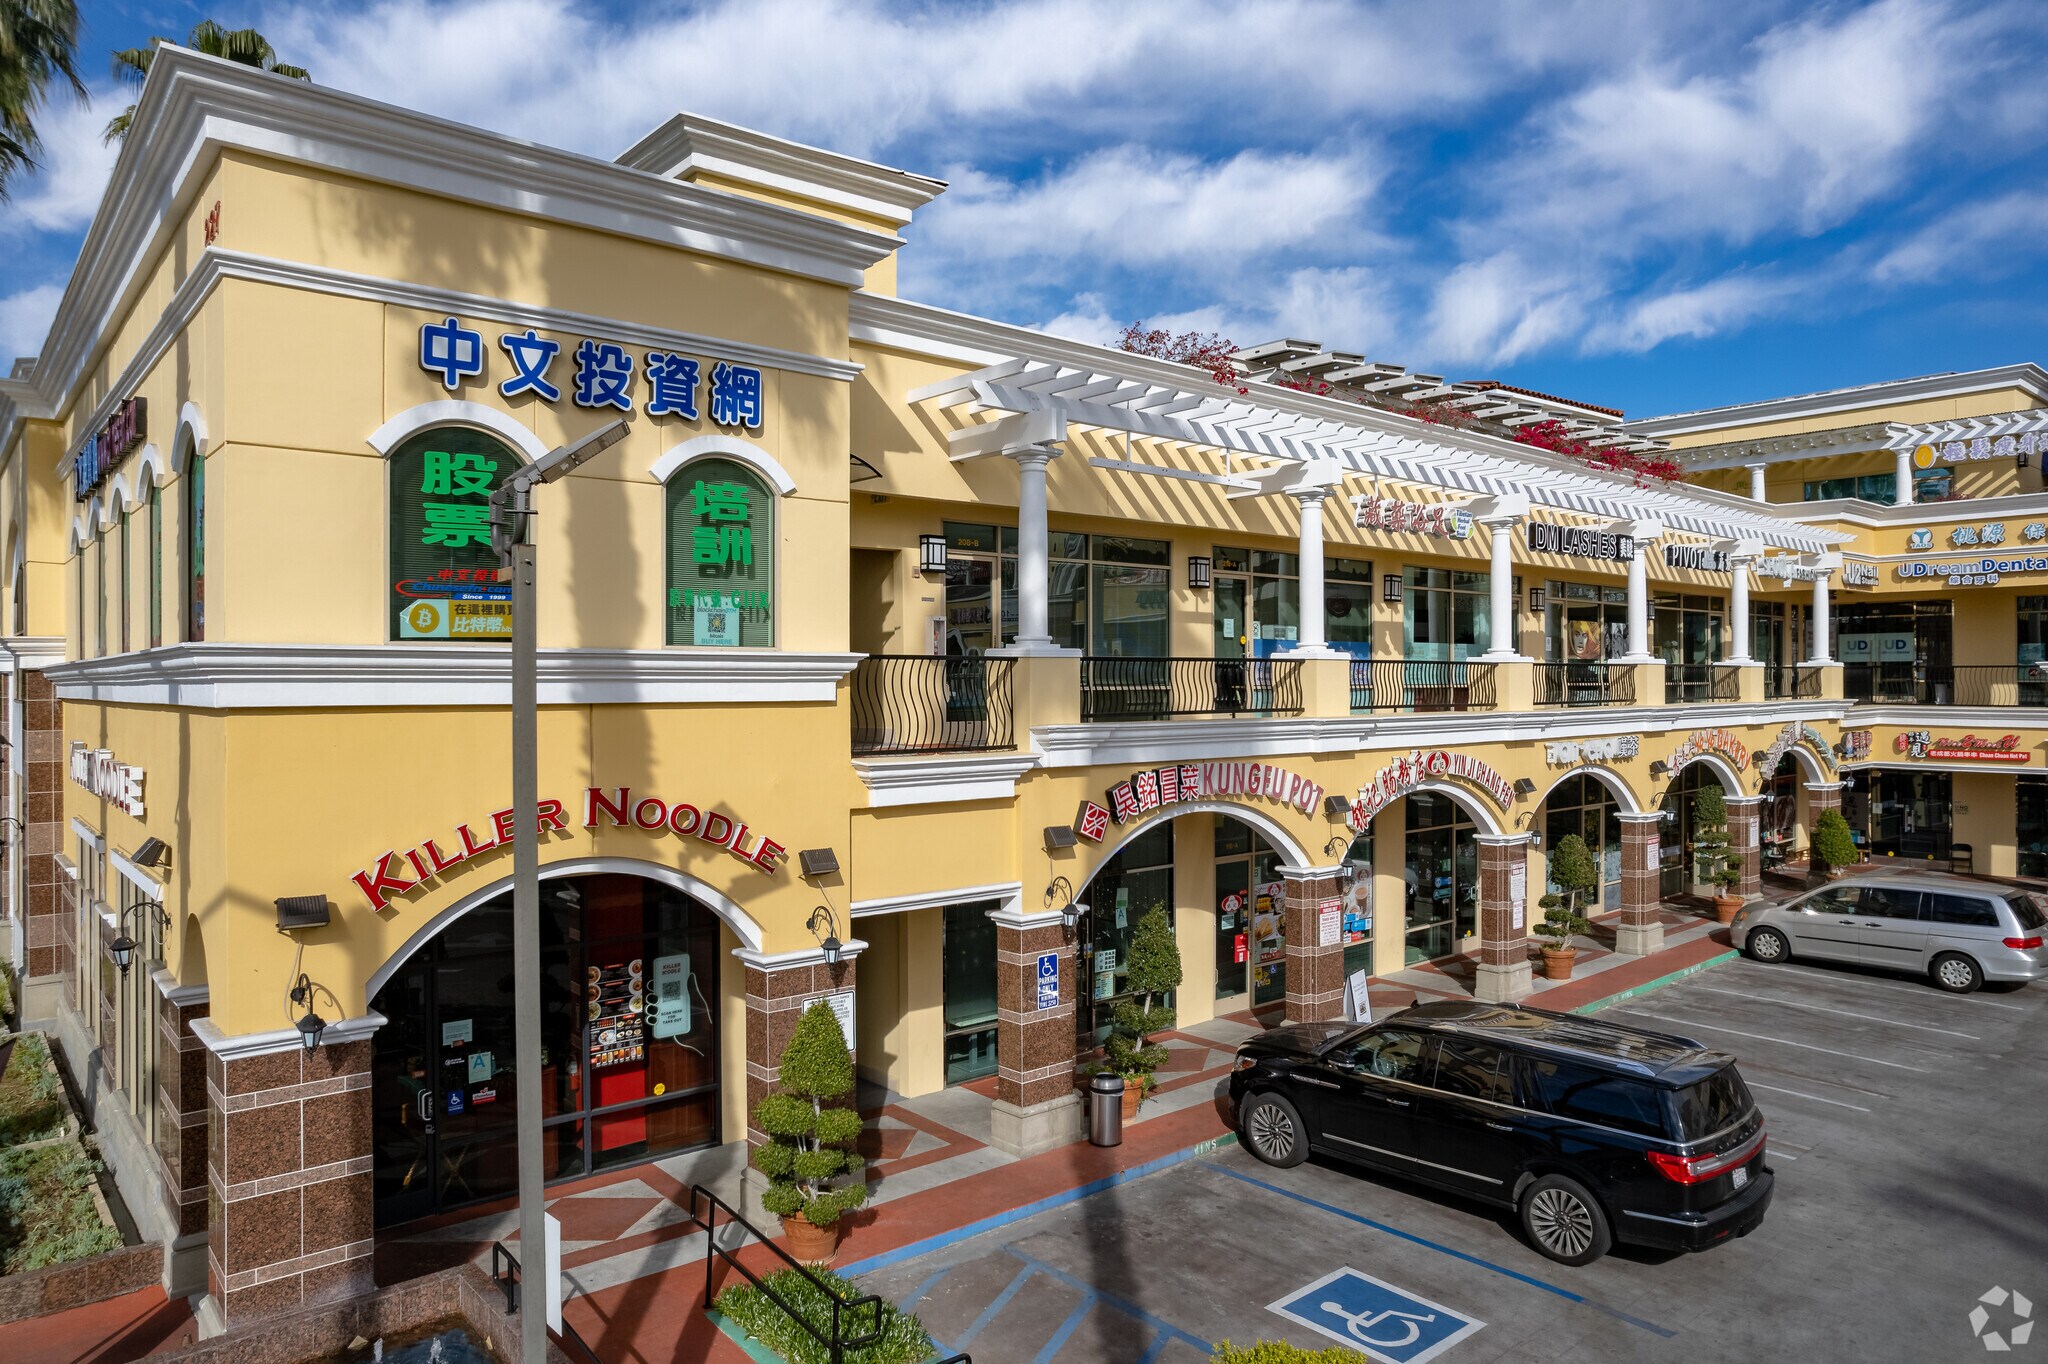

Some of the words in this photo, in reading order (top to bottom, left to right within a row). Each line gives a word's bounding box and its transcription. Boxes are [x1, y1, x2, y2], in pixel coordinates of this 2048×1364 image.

[421, 317, 762, 428] 中文投資網
[421, 451, 497, 547] 股票
[690, 480, 752, 565] 培訓
[1456, 509, 1472, 518] Tibetan
[1536, 523, 1559, 551] DM
[1562, 526, 1617, 559] LASHES
[1952, 522, 2006, 546] 桃源
[1672, 545, 1703, 570] PIVOT
[1861, 564, 1879, 577] Nail
[1847, 640, 1868, 650] UD
[1885, 639, 1907, 650] UD
[1203, 763, 1287, 799] KUNGFU
[1290, 773, 1324, 815] POT
[1454, 754, 1467, 774] YIN
[1476, 761, 1502, 793] CHANG
[1502, 782, 1515, 808] FEN
[352, 799, 566, 912] KILLER
[583, 787, 786, 876] NOODLE
[1040, 975, 1057, 983] PARKING
[472, 1055, 485, 1069] A
